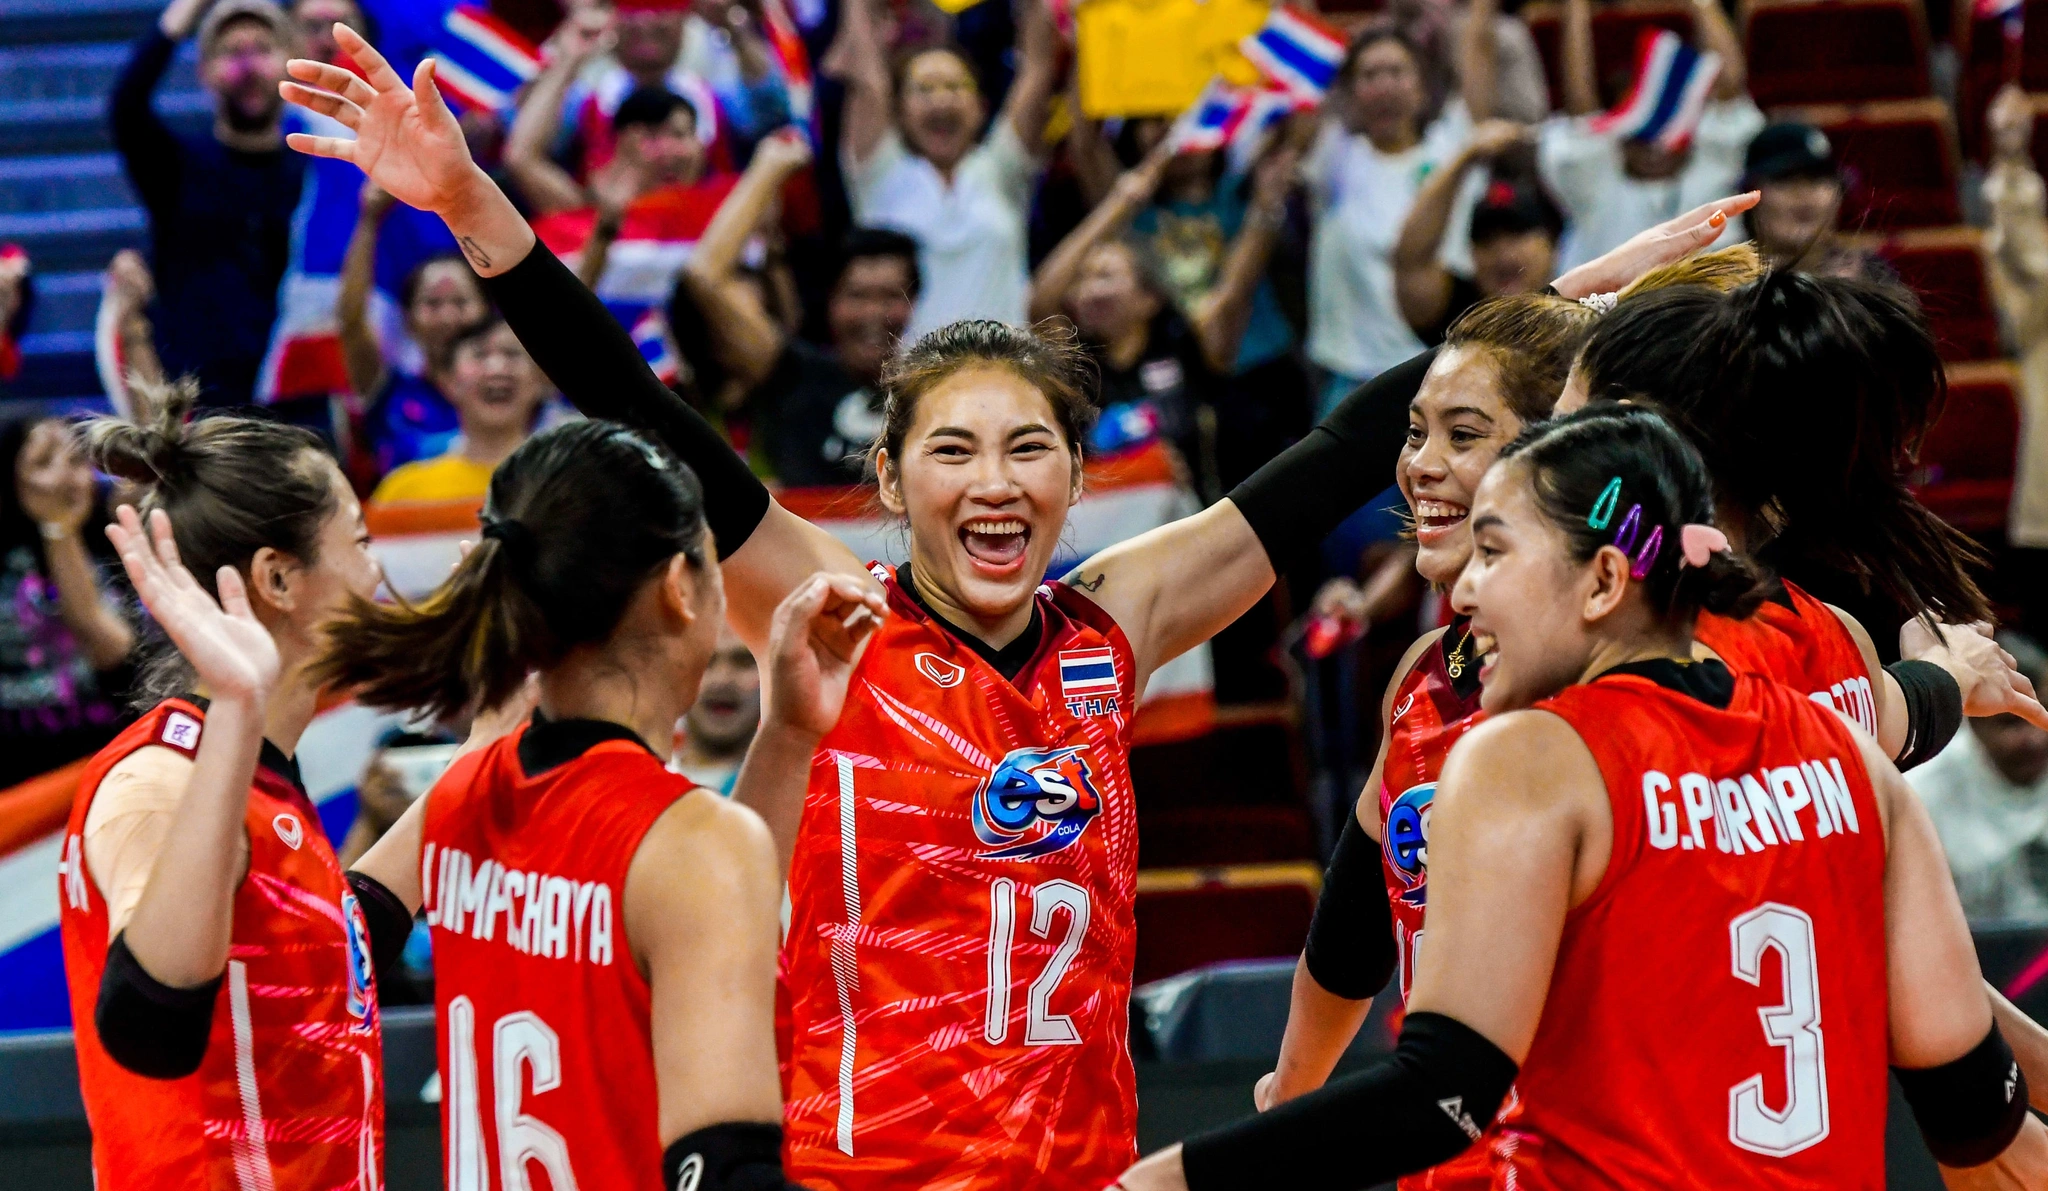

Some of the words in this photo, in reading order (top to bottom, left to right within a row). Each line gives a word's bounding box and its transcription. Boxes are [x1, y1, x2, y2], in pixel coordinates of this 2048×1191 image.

[1065, 697, 1121, 718] THA
[986, 752, 1099, 830] est
[1057, 823, 1081, 836] COLA
[984, 876, 1092, 1046] 12
[1728, 901, 1830, 1158] 3
[448, 994, 580, 1191] 16
